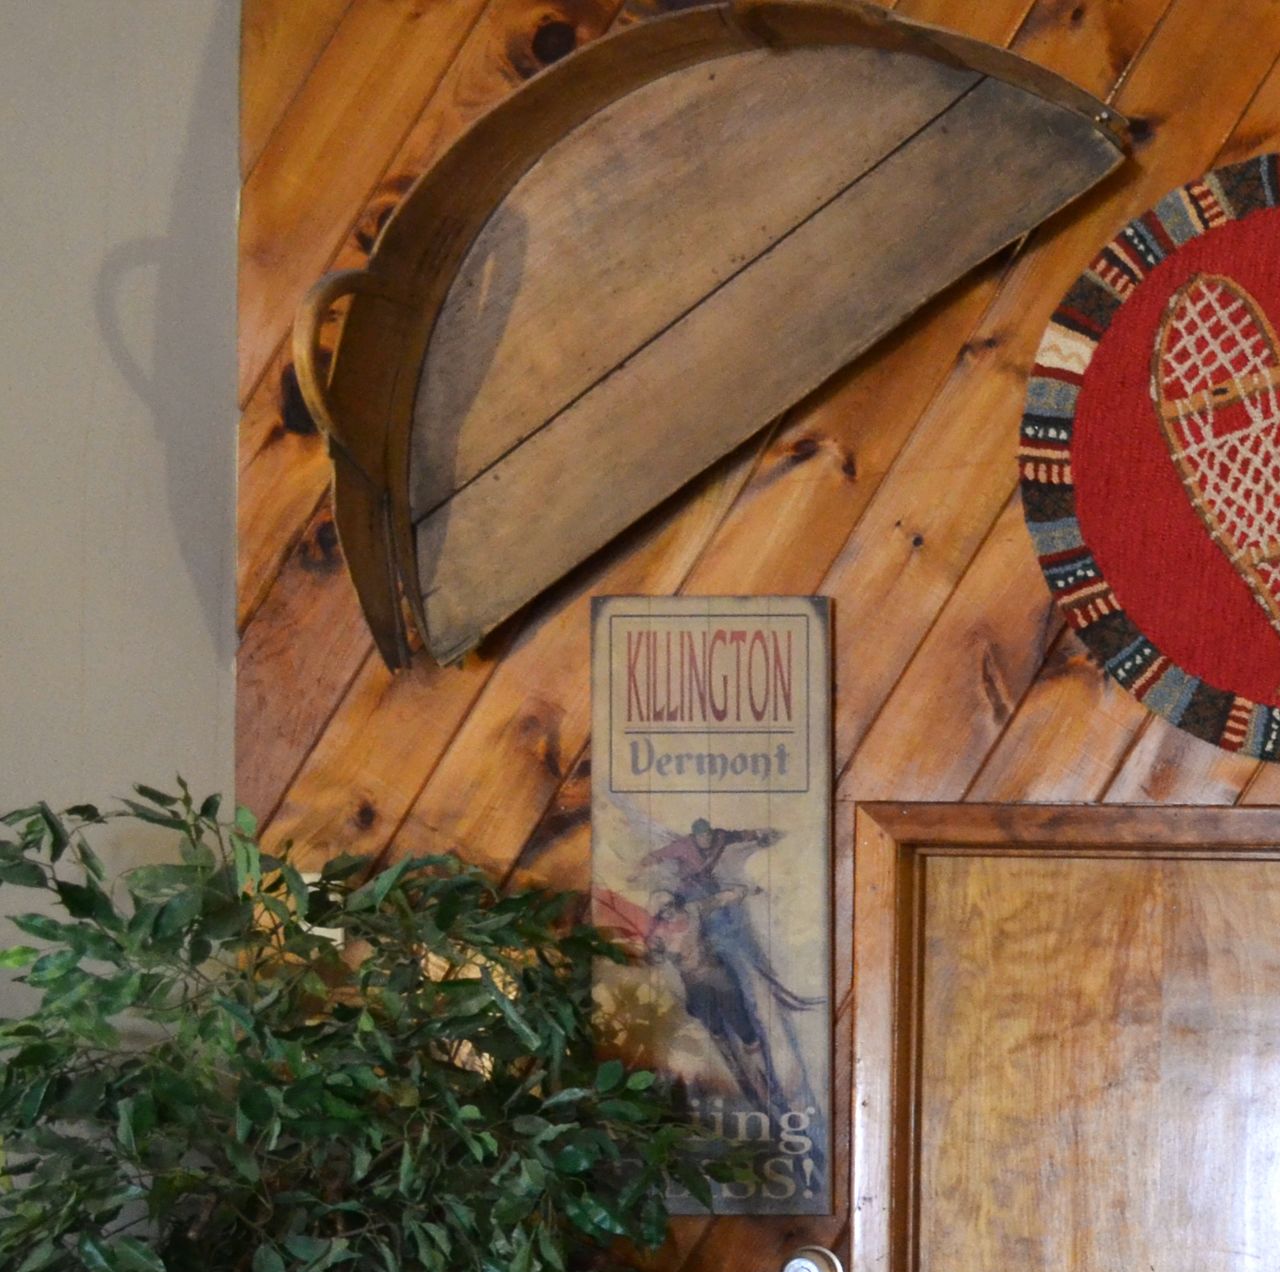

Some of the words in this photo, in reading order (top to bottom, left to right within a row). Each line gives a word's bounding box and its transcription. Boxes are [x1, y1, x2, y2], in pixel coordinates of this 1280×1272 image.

[626, 629, 793, 722] KILLINGTON
[630, 737, 789, 781] Vermont
[686, 1098, 816, 1155] iing
